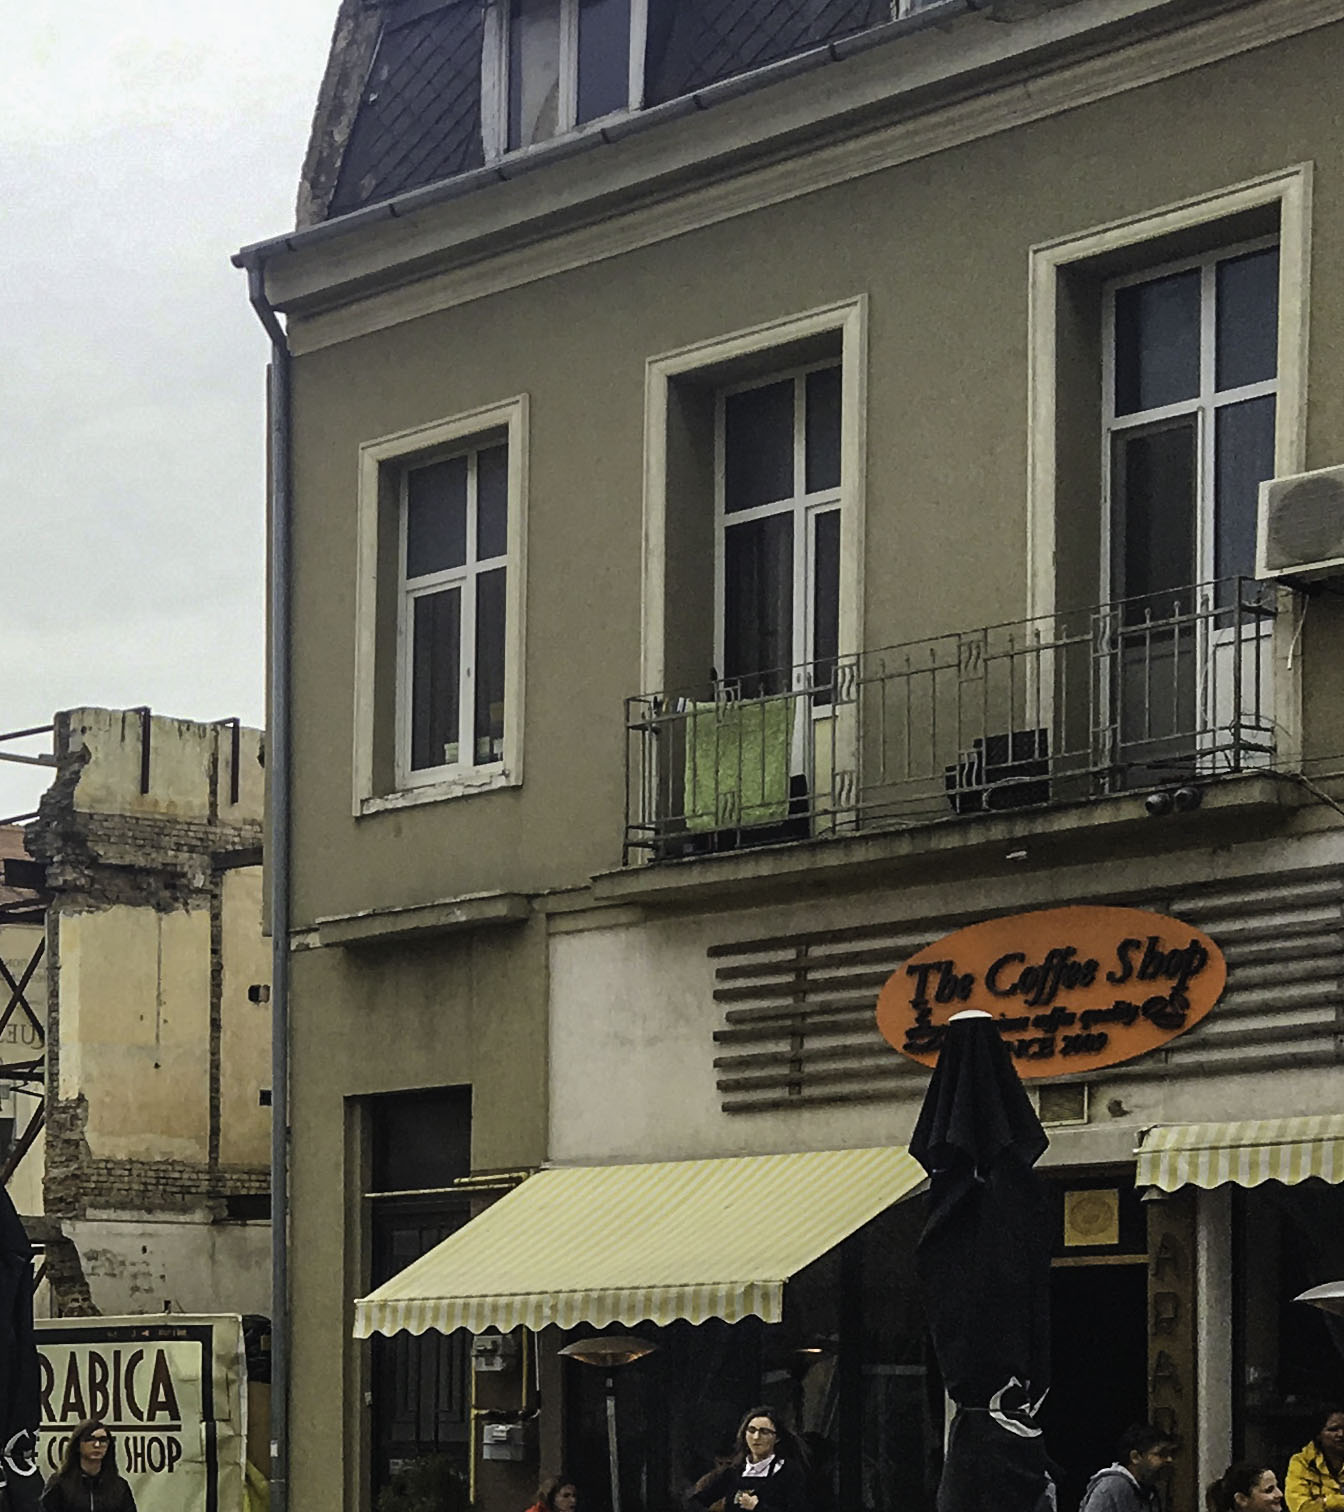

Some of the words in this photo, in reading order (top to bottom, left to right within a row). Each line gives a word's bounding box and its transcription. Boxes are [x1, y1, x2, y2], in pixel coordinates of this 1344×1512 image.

[905, 959, 976, 1004] The
[984, 946, 1101, 1007] Coffee
[1106, 935, 1210, 998] Shop
[38, 1348, 182, 1423] RABICA
[125, 1436, 182, 1473] SHOP
